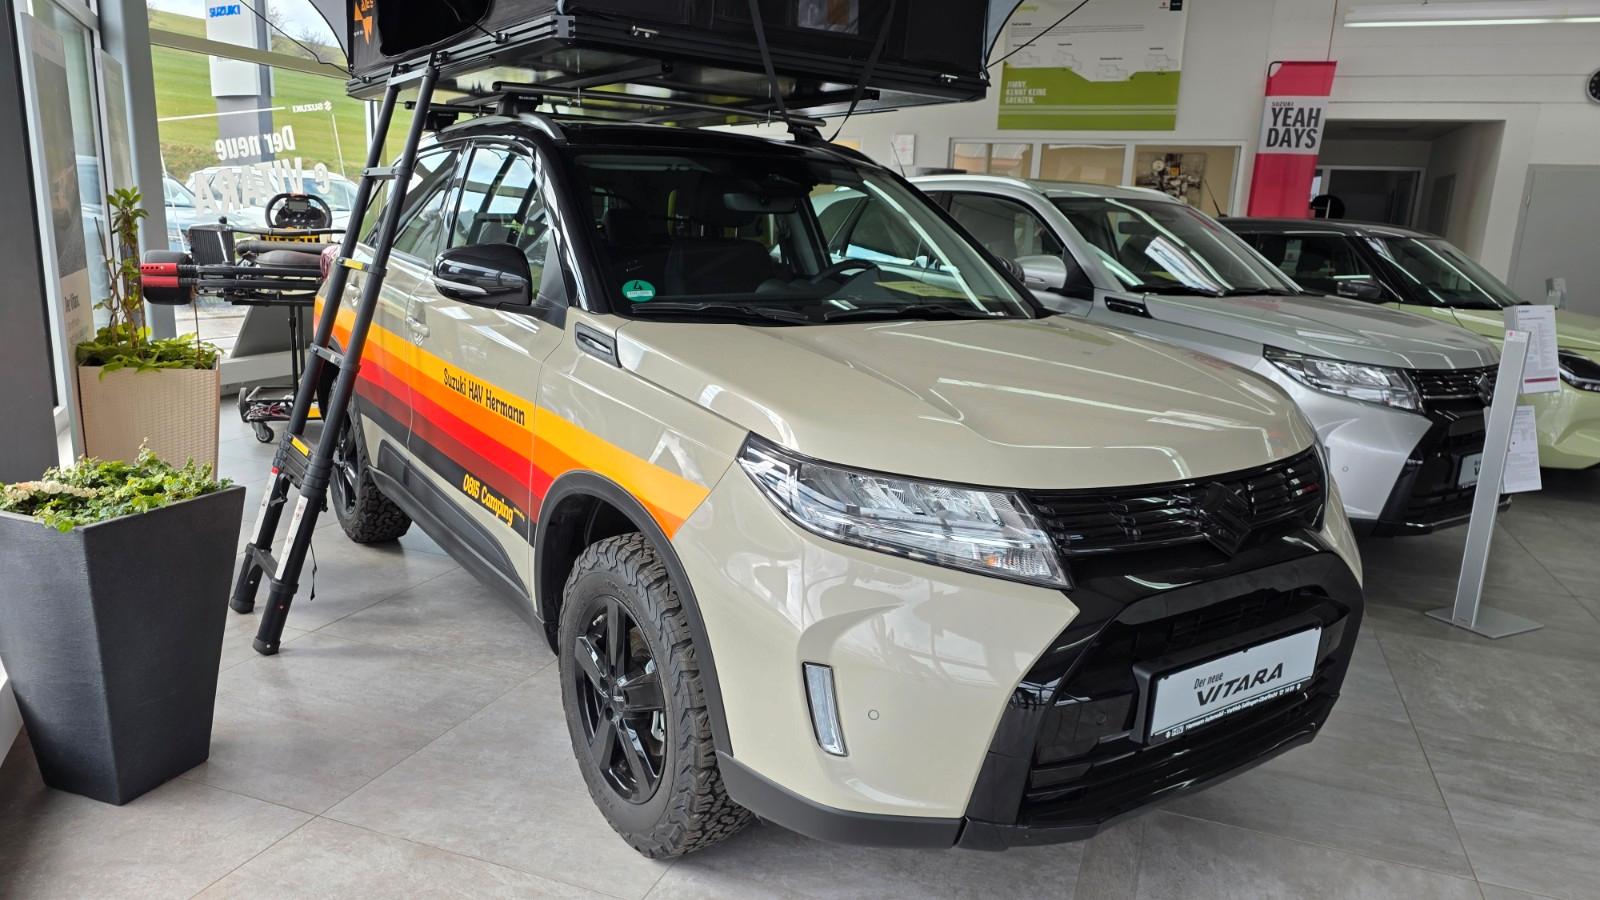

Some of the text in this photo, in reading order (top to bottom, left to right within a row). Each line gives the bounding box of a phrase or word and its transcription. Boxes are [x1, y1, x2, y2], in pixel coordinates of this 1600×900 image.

[209, 5, 240, 17] SUZUKI
[1271, 107, 1321, 128] YEAH
[1266, 128, 1318, 149] DAYS
[443, 367, 525, 426] Suzuki HAV Hermann
[463, 473, 514, 528] 0815 Camping
[1194, 672, 1224, 690] Der neue
[1197, 662, 1284, 707] VITARA
